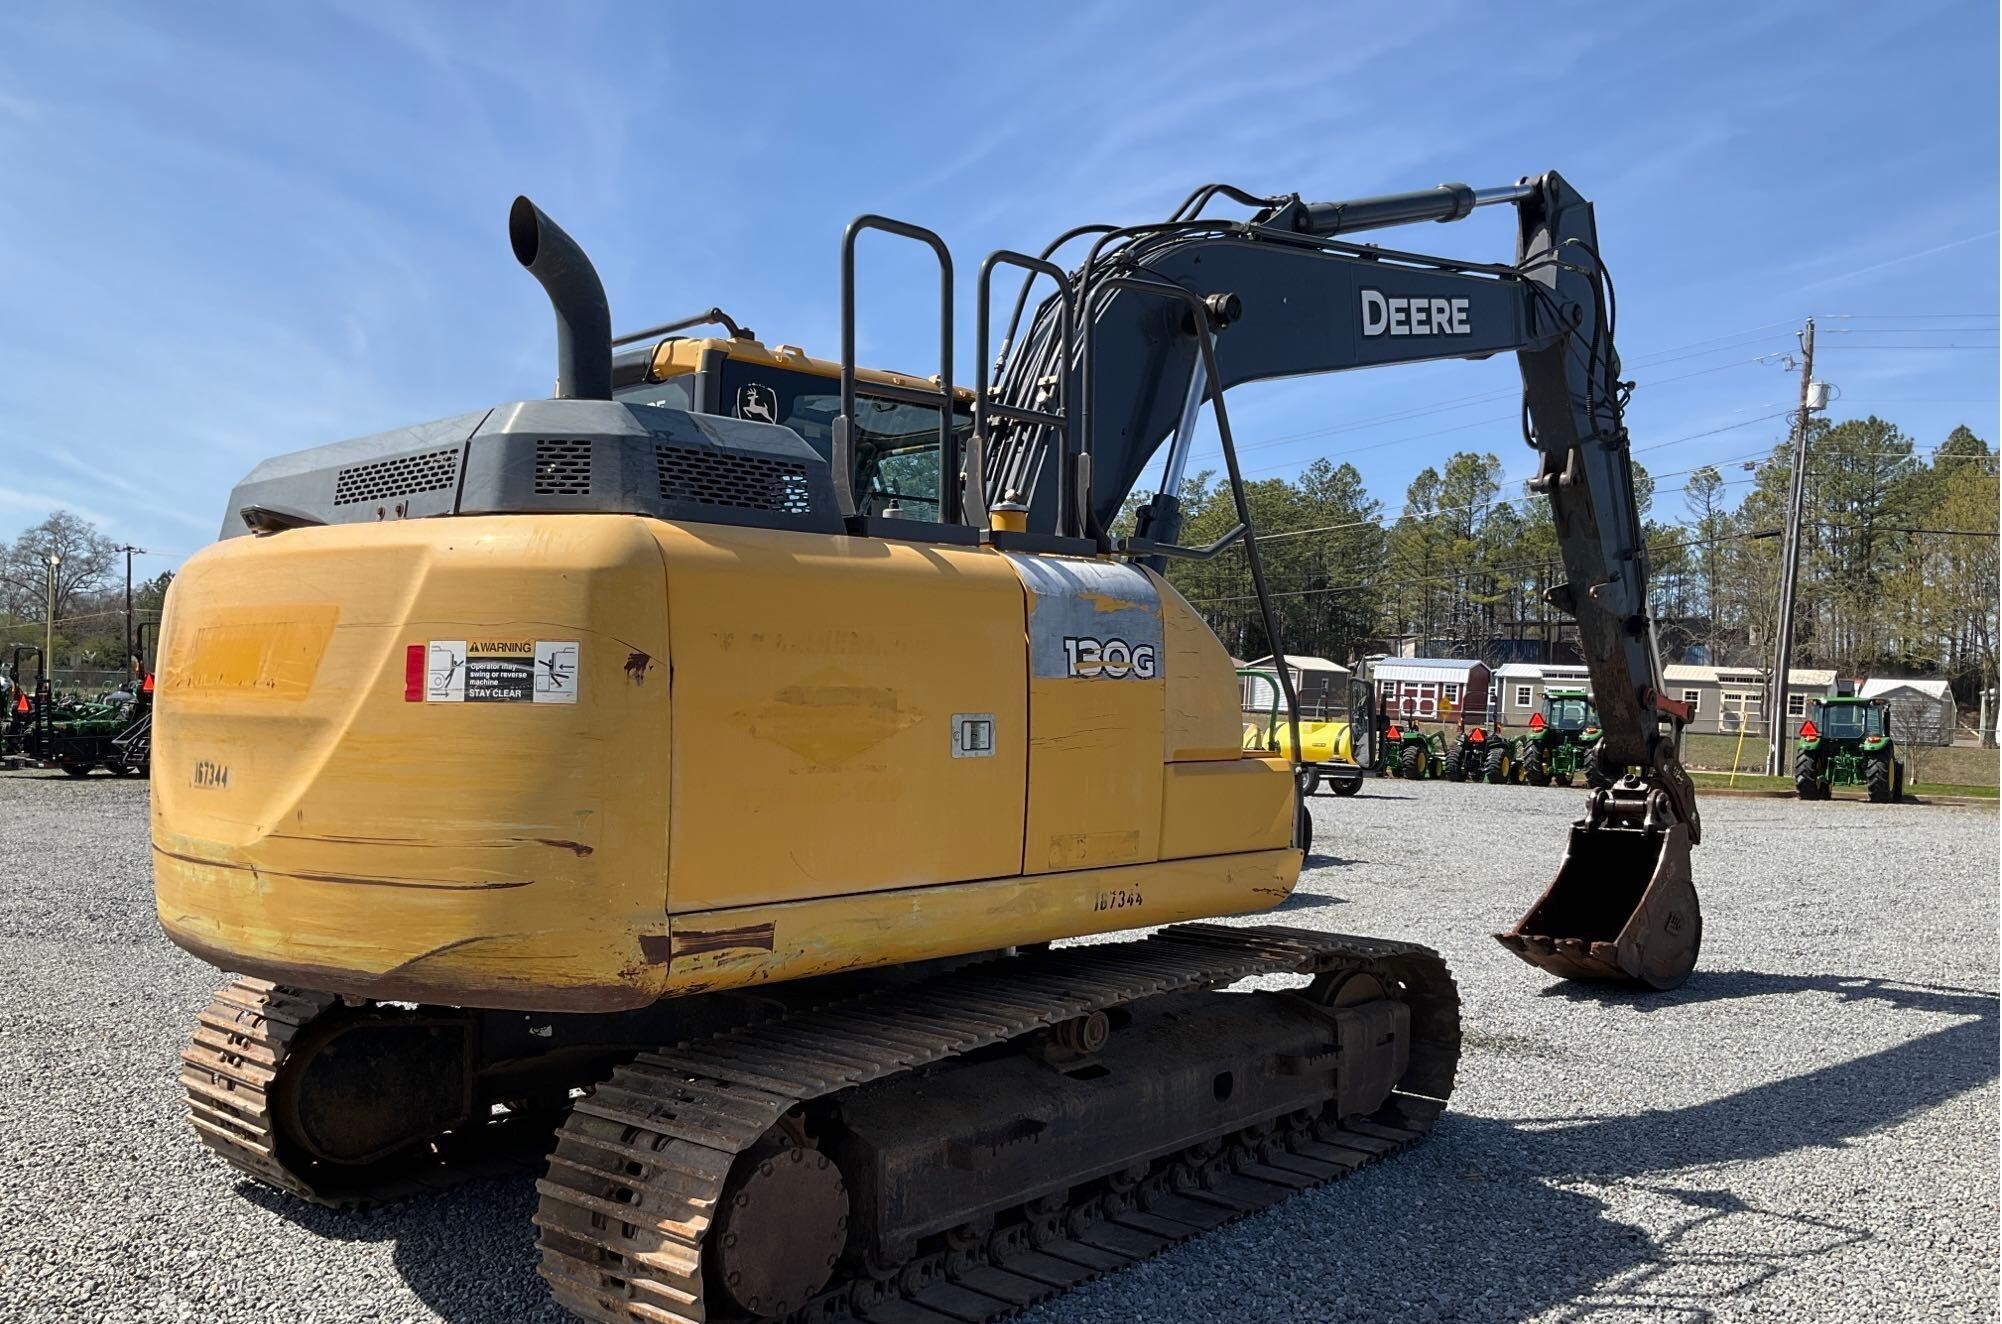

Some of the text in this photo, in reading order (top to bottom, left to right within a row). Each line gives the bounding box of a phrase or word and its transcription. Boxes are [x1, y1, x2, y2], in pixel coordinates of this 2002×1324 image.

[1361, 290, 1471, 336] DEERE
[480, 642, 532, 653] WARNING
[1063, 636, 1155, 680] 130G
[470, 662, 518, 671] Operator may
[470, 671, 490, 679] swing
[469, 689, 521, 698] STAY CLEAR
[194, 761, 227, 788] 167344
